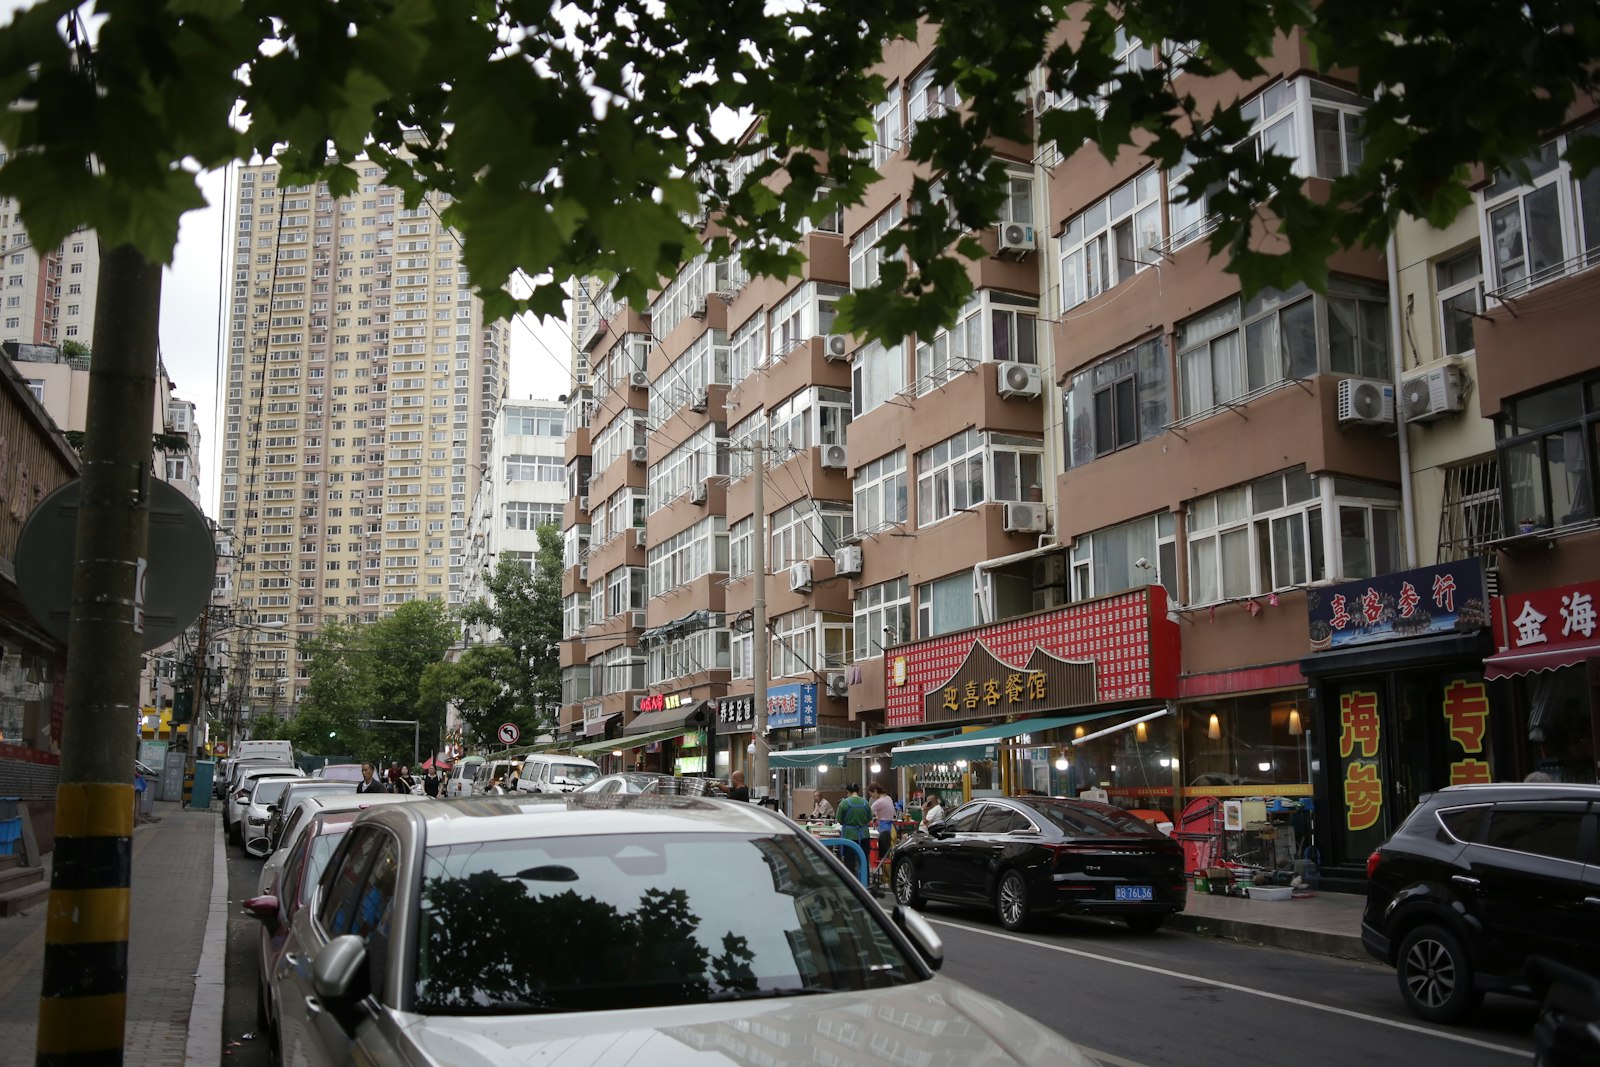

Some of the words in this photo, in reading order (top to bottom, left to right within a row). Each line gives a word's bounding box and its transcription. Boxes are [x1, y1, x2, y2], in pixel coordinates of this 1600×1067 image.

[1330, 574, 1456, 630] 喜客参行
[1512, 592, 1598, 647] 金海
[803, 684, 814, 725] 干洗水洗
[942, 670, 1048, 712] 迎喜客餐馆
[1339, 691, 1383, 831] 海参
